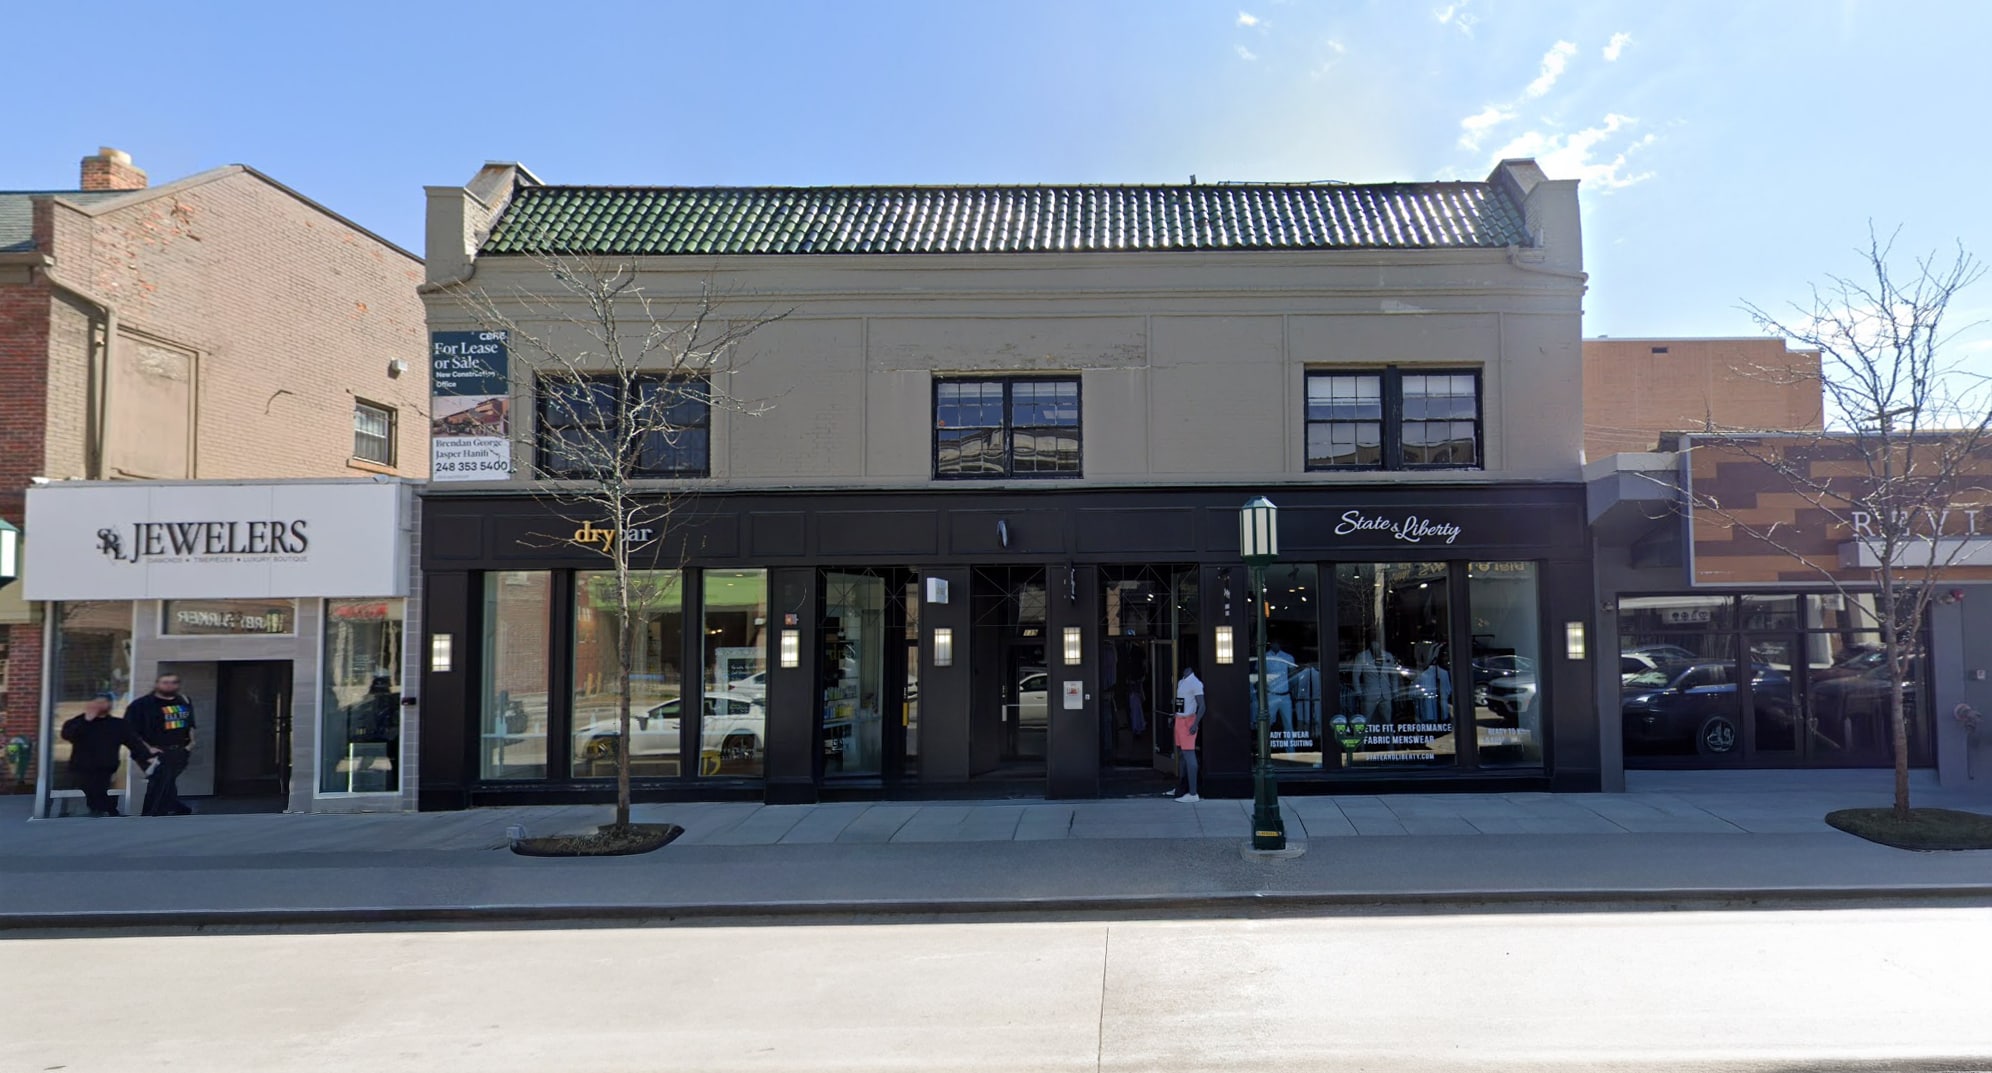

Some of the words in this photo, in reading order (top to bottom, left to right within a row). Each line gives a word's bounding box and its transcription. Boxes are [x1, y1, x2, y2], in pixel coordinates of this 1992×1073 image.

[434, 342, 459, 355] For
[461, 342, 498, 354] Lease
[434, 360, 450, 370] or
[452, 356, 479, 370] Sale
[436, 380, 456, 388] Office
[436, 439, 471, 447] Brendan
[473, 439, 501, 448] George
[436, 450, 462, 459] Jasper
[436, 462, 455, 471] 248
[458, 462, 477, 471] 353
[480, 461, 508, 471] 5400
[1334, 510, 1391, 535] State
[1390, 522, 1400, 532] &
[1394, 515, 1461, 544] Liberty
[130, 519, 309, 563] JEWELERS
[1382, 724, 1396, 733] FIT,
[1397, 723, 1453, 732] PERFORMANCE
[1364, 736, 1390, 744] FABRIC
[1392, 735, 1435, 744] MENSWEAR
